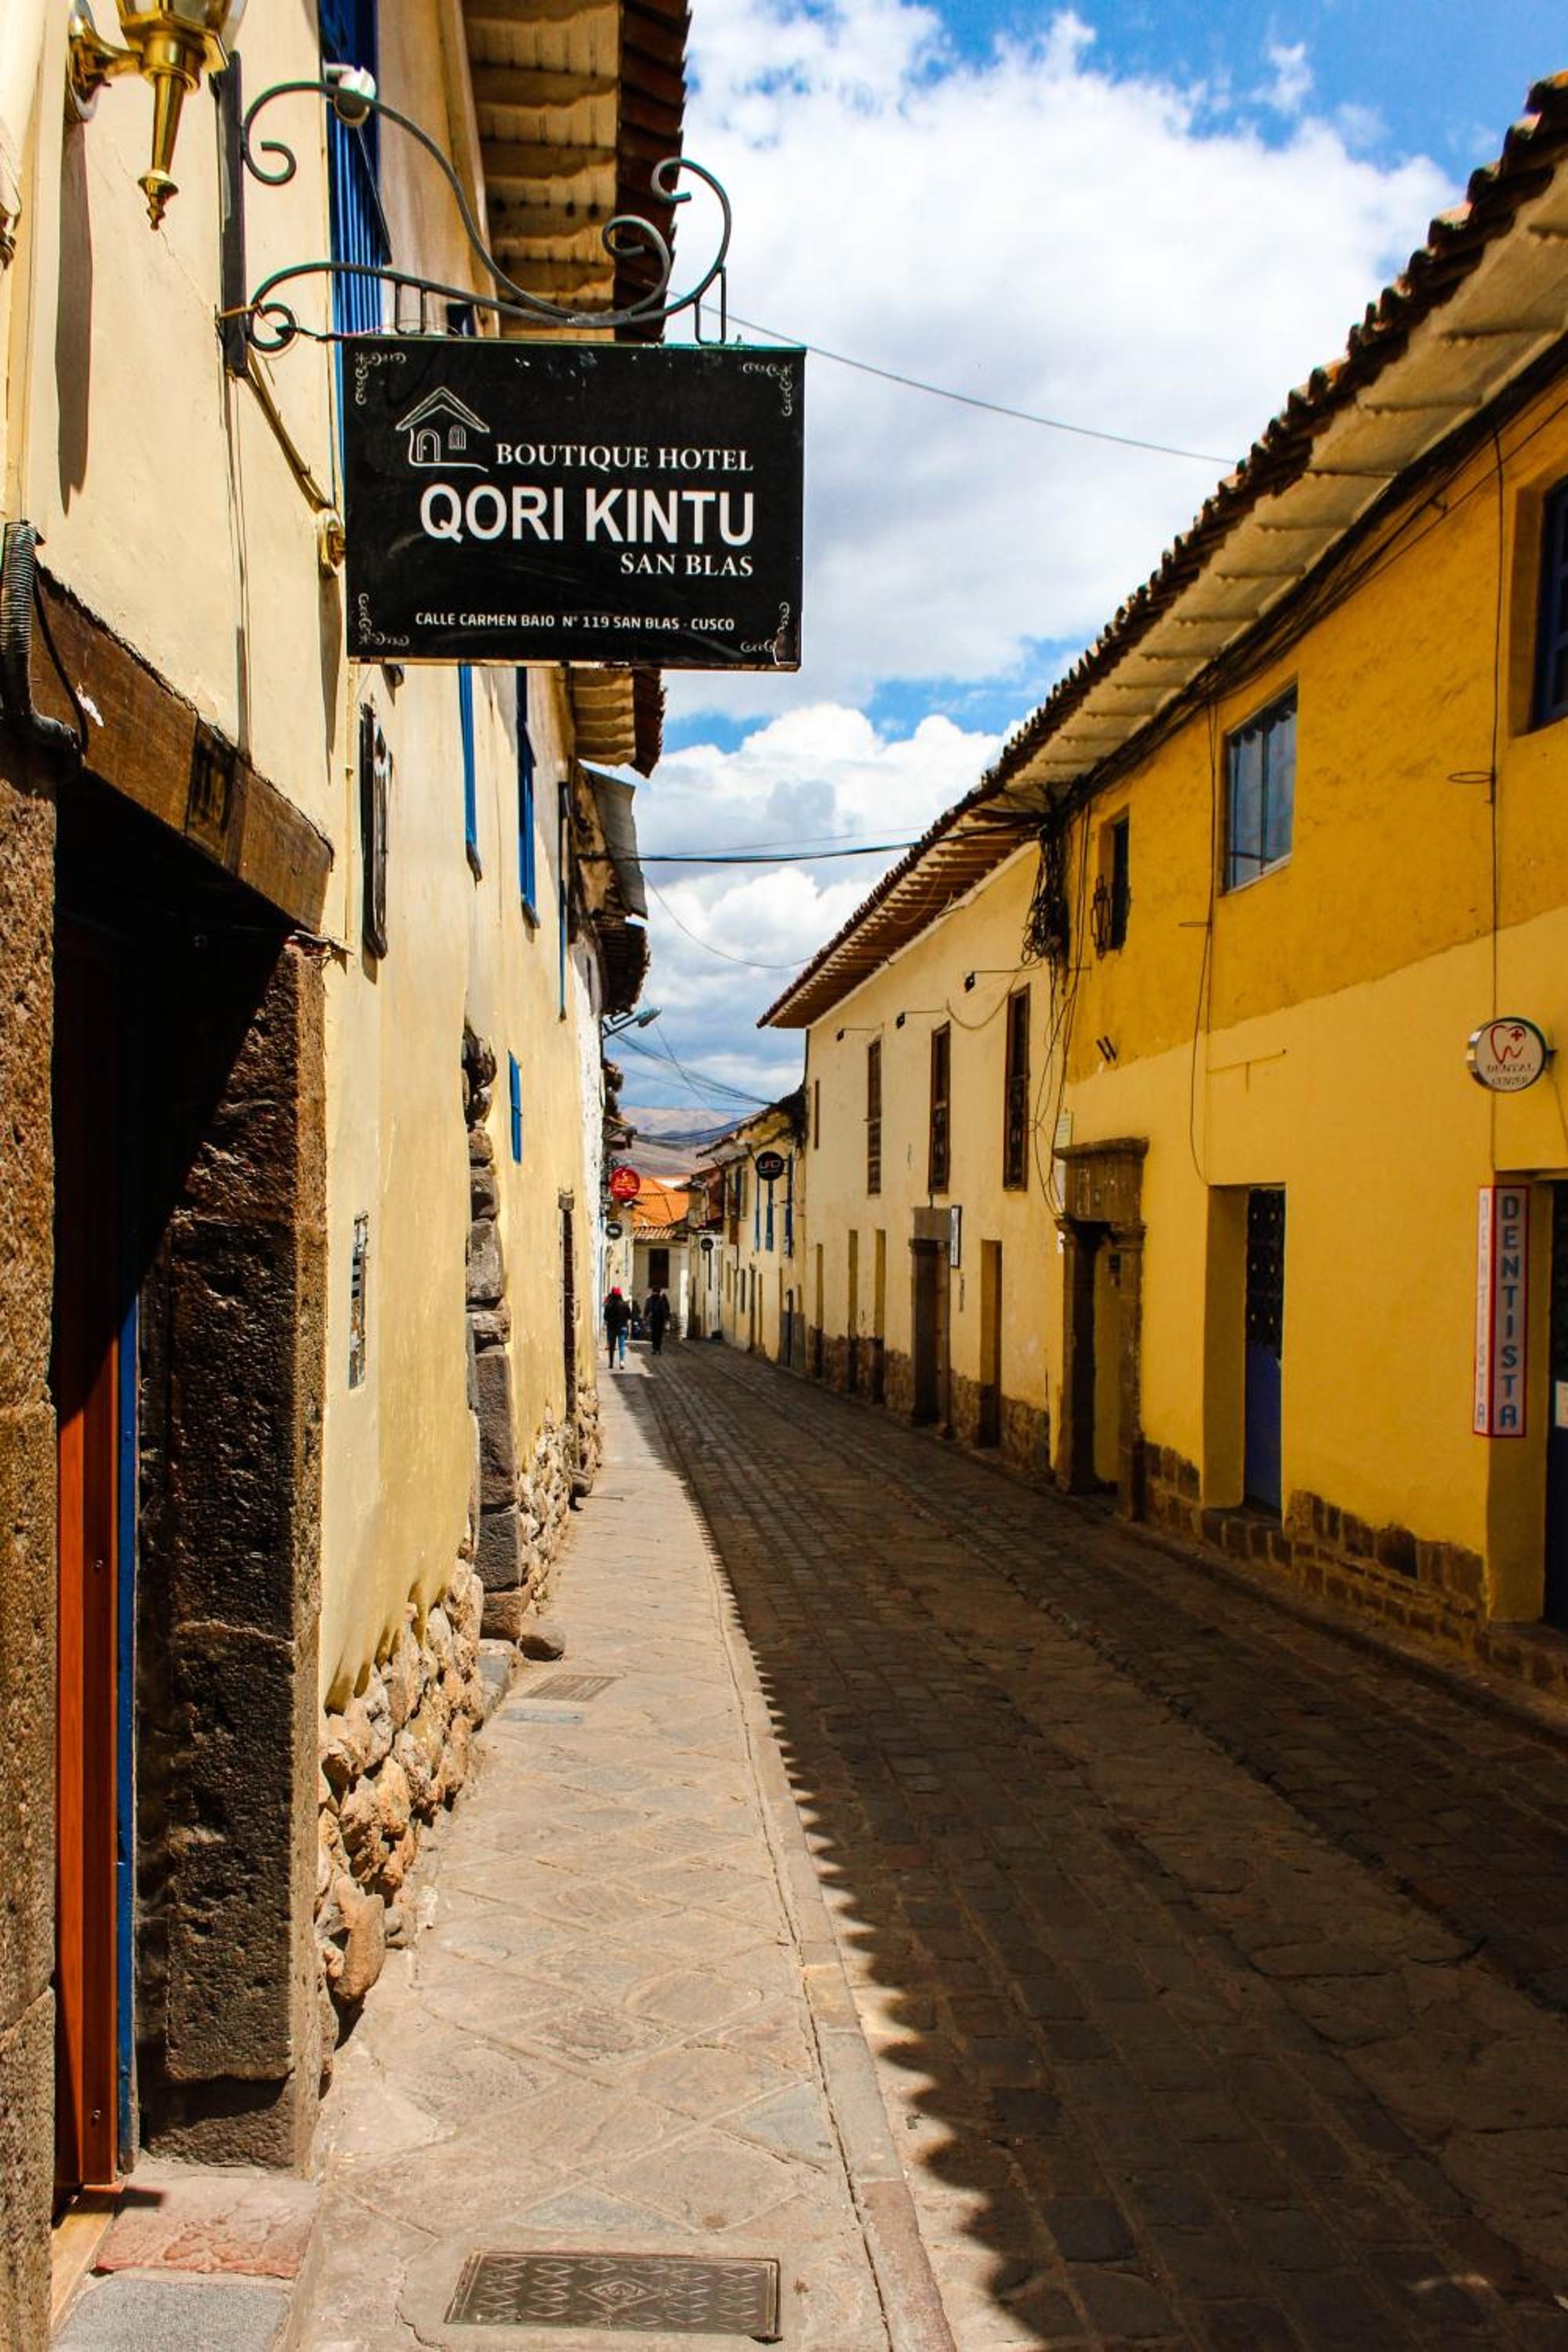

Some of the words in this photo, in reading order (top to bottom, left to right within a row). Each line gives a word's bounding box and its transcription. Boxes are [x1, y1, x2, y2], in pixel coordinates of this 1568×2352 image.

[496, 443, 650, 472] BOUTIQUE
[657, 448, 754, 471] HOTEL
[420, 483, 564, 544] QORI
[586, 488, 754, 546] KINTU
[621, 552, 676, 575] SAN
[685, 554, 753, 577] BLAS
[415, 612, 456, 626] CALLE
[459, 613, 517, 626] CARMEN
[582, 615, 609, 628] 119
[613, 616, 641, 629] SAN
[644, 617, 679, 630] BLAS
[690, 617, 735, 631] CUSCO
[1499, 1195, 1521, 1429] DENTISTA
